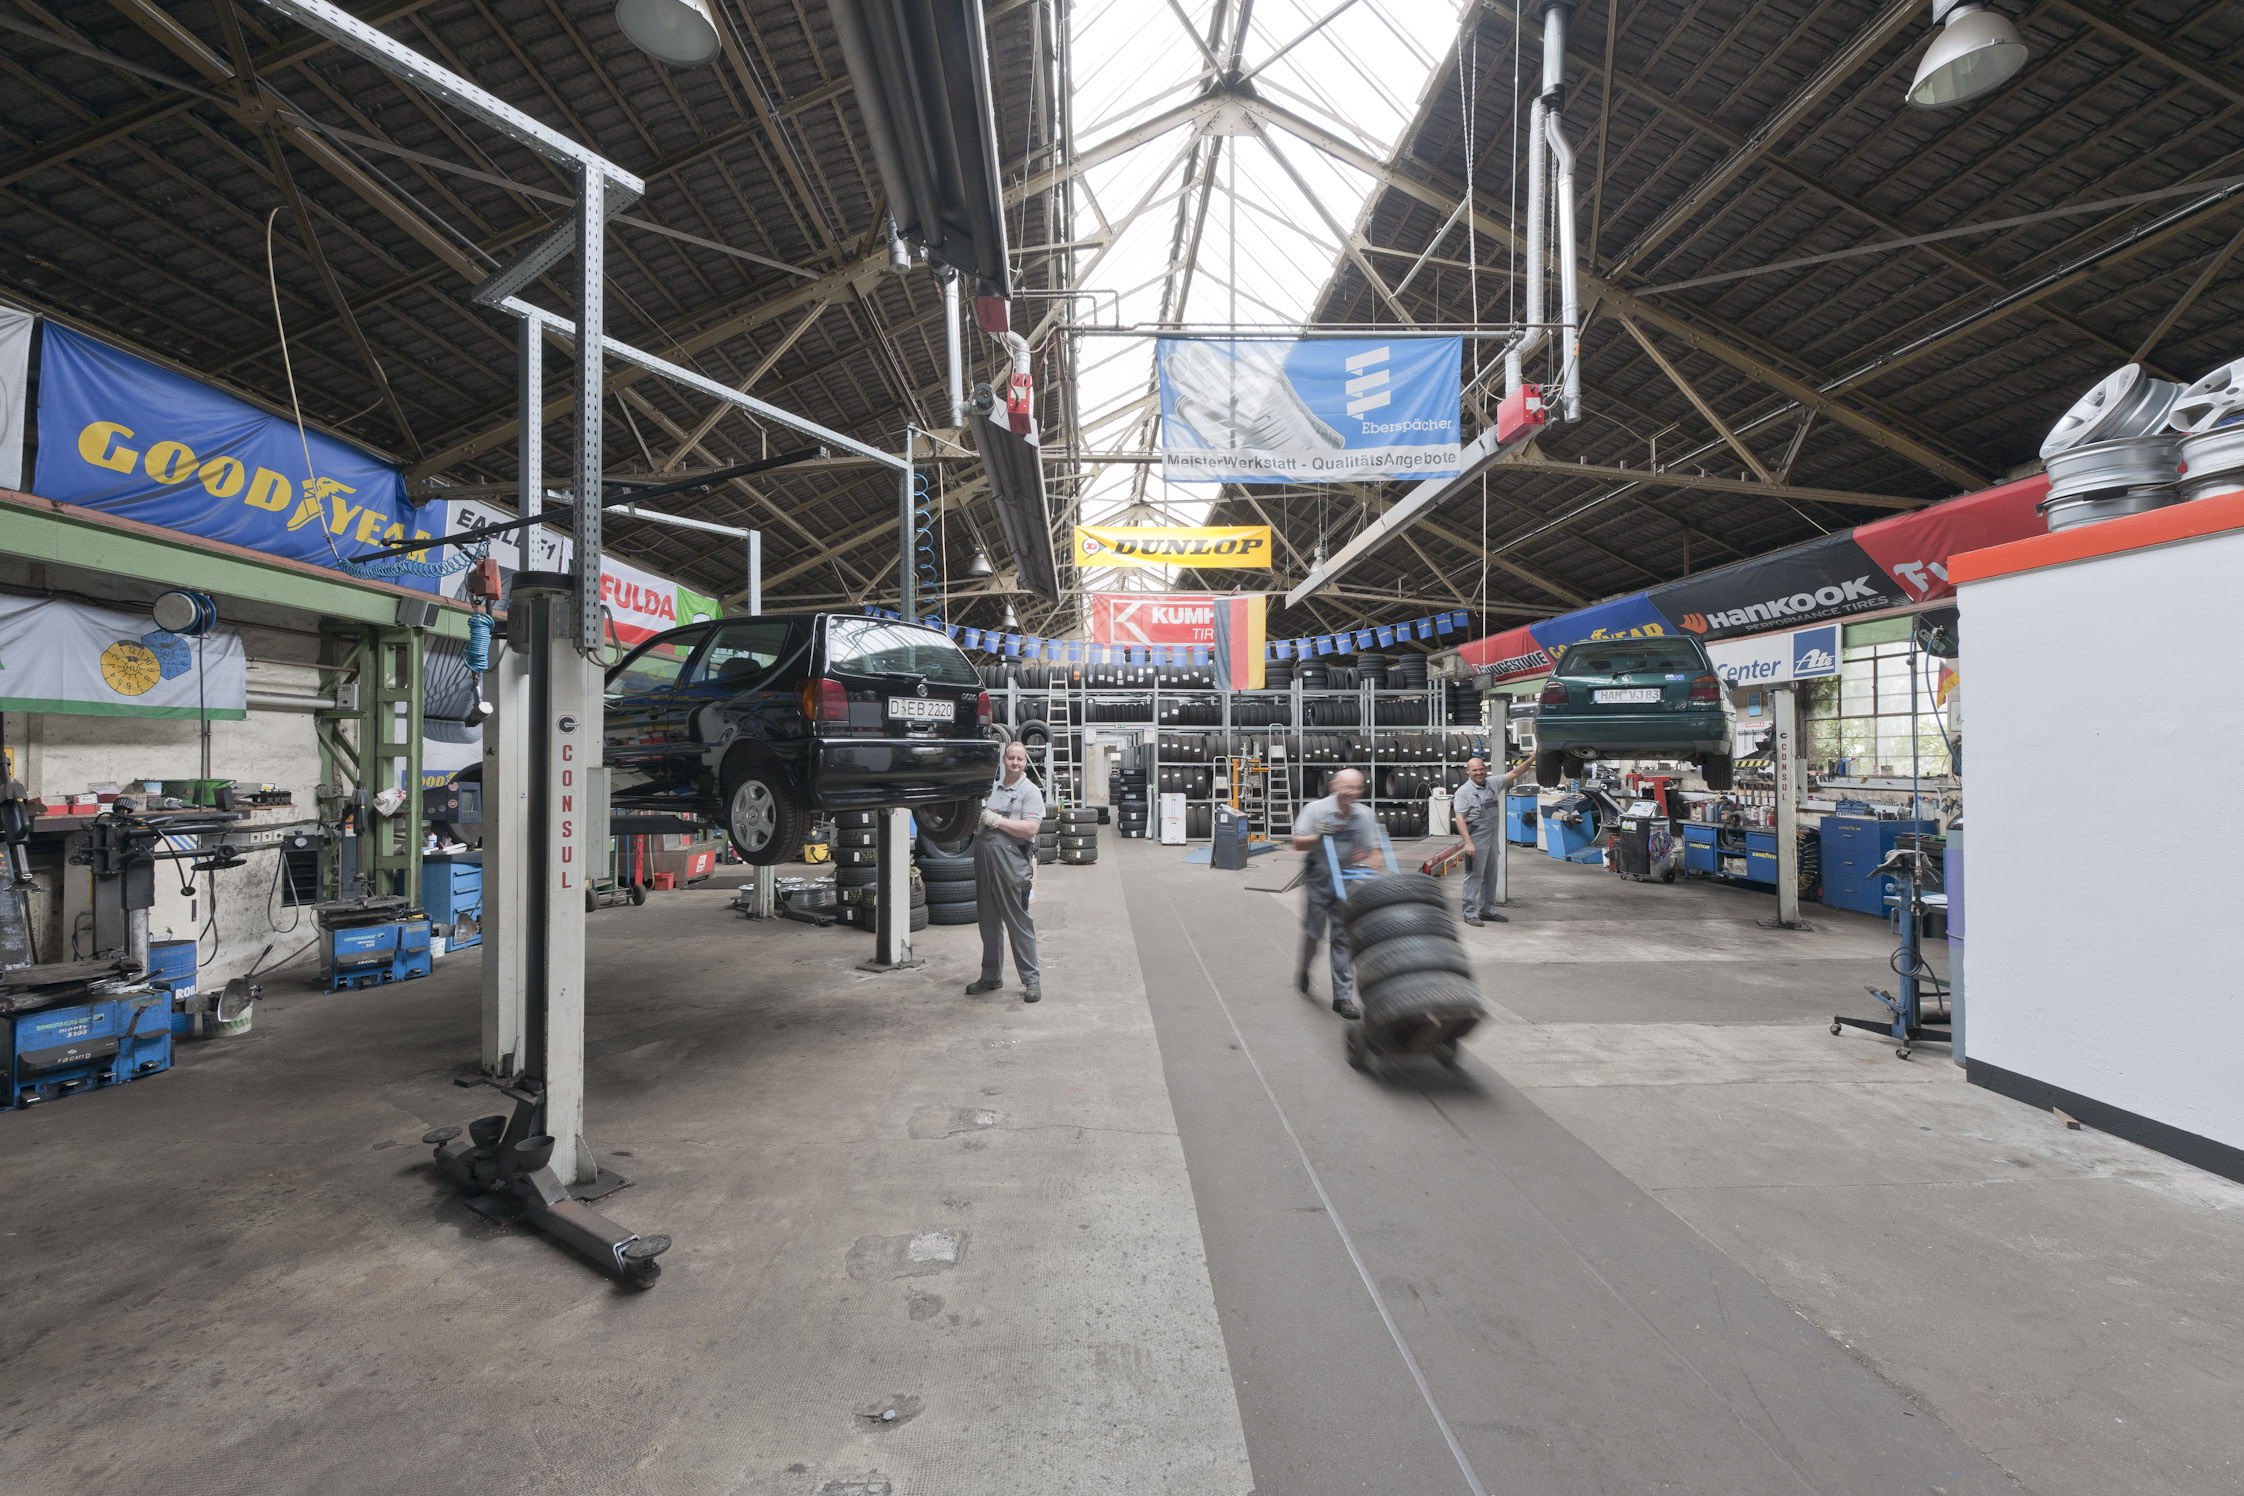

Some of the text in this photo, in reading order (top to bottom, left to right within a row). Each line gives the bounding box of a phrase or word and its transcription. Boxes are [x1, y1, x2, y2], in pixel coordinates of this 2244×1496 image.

[1361, 418, 1452, 434] Eberspächer
[1167, 454, 1297, 470] MeisterWerkstatt
[1312, 451, 1457, 470] QualitätsAngebote
[1111, 539, 1263, 555] DUNLOP
[600, 572, 676, 622] FULDA
[1152, 607, 1214, 624] KUMH
[1745, 595, 1889, 632] PERFORMANCE TIRES
[1794, 648, 1836, 673] Ate
[1600, 691, 1623, 700] HAM
[890, 700, 952, 717] D EB 2220
[562, 744, 573, 889] CONSUL
[57, 1051, 92, 1064] racing
